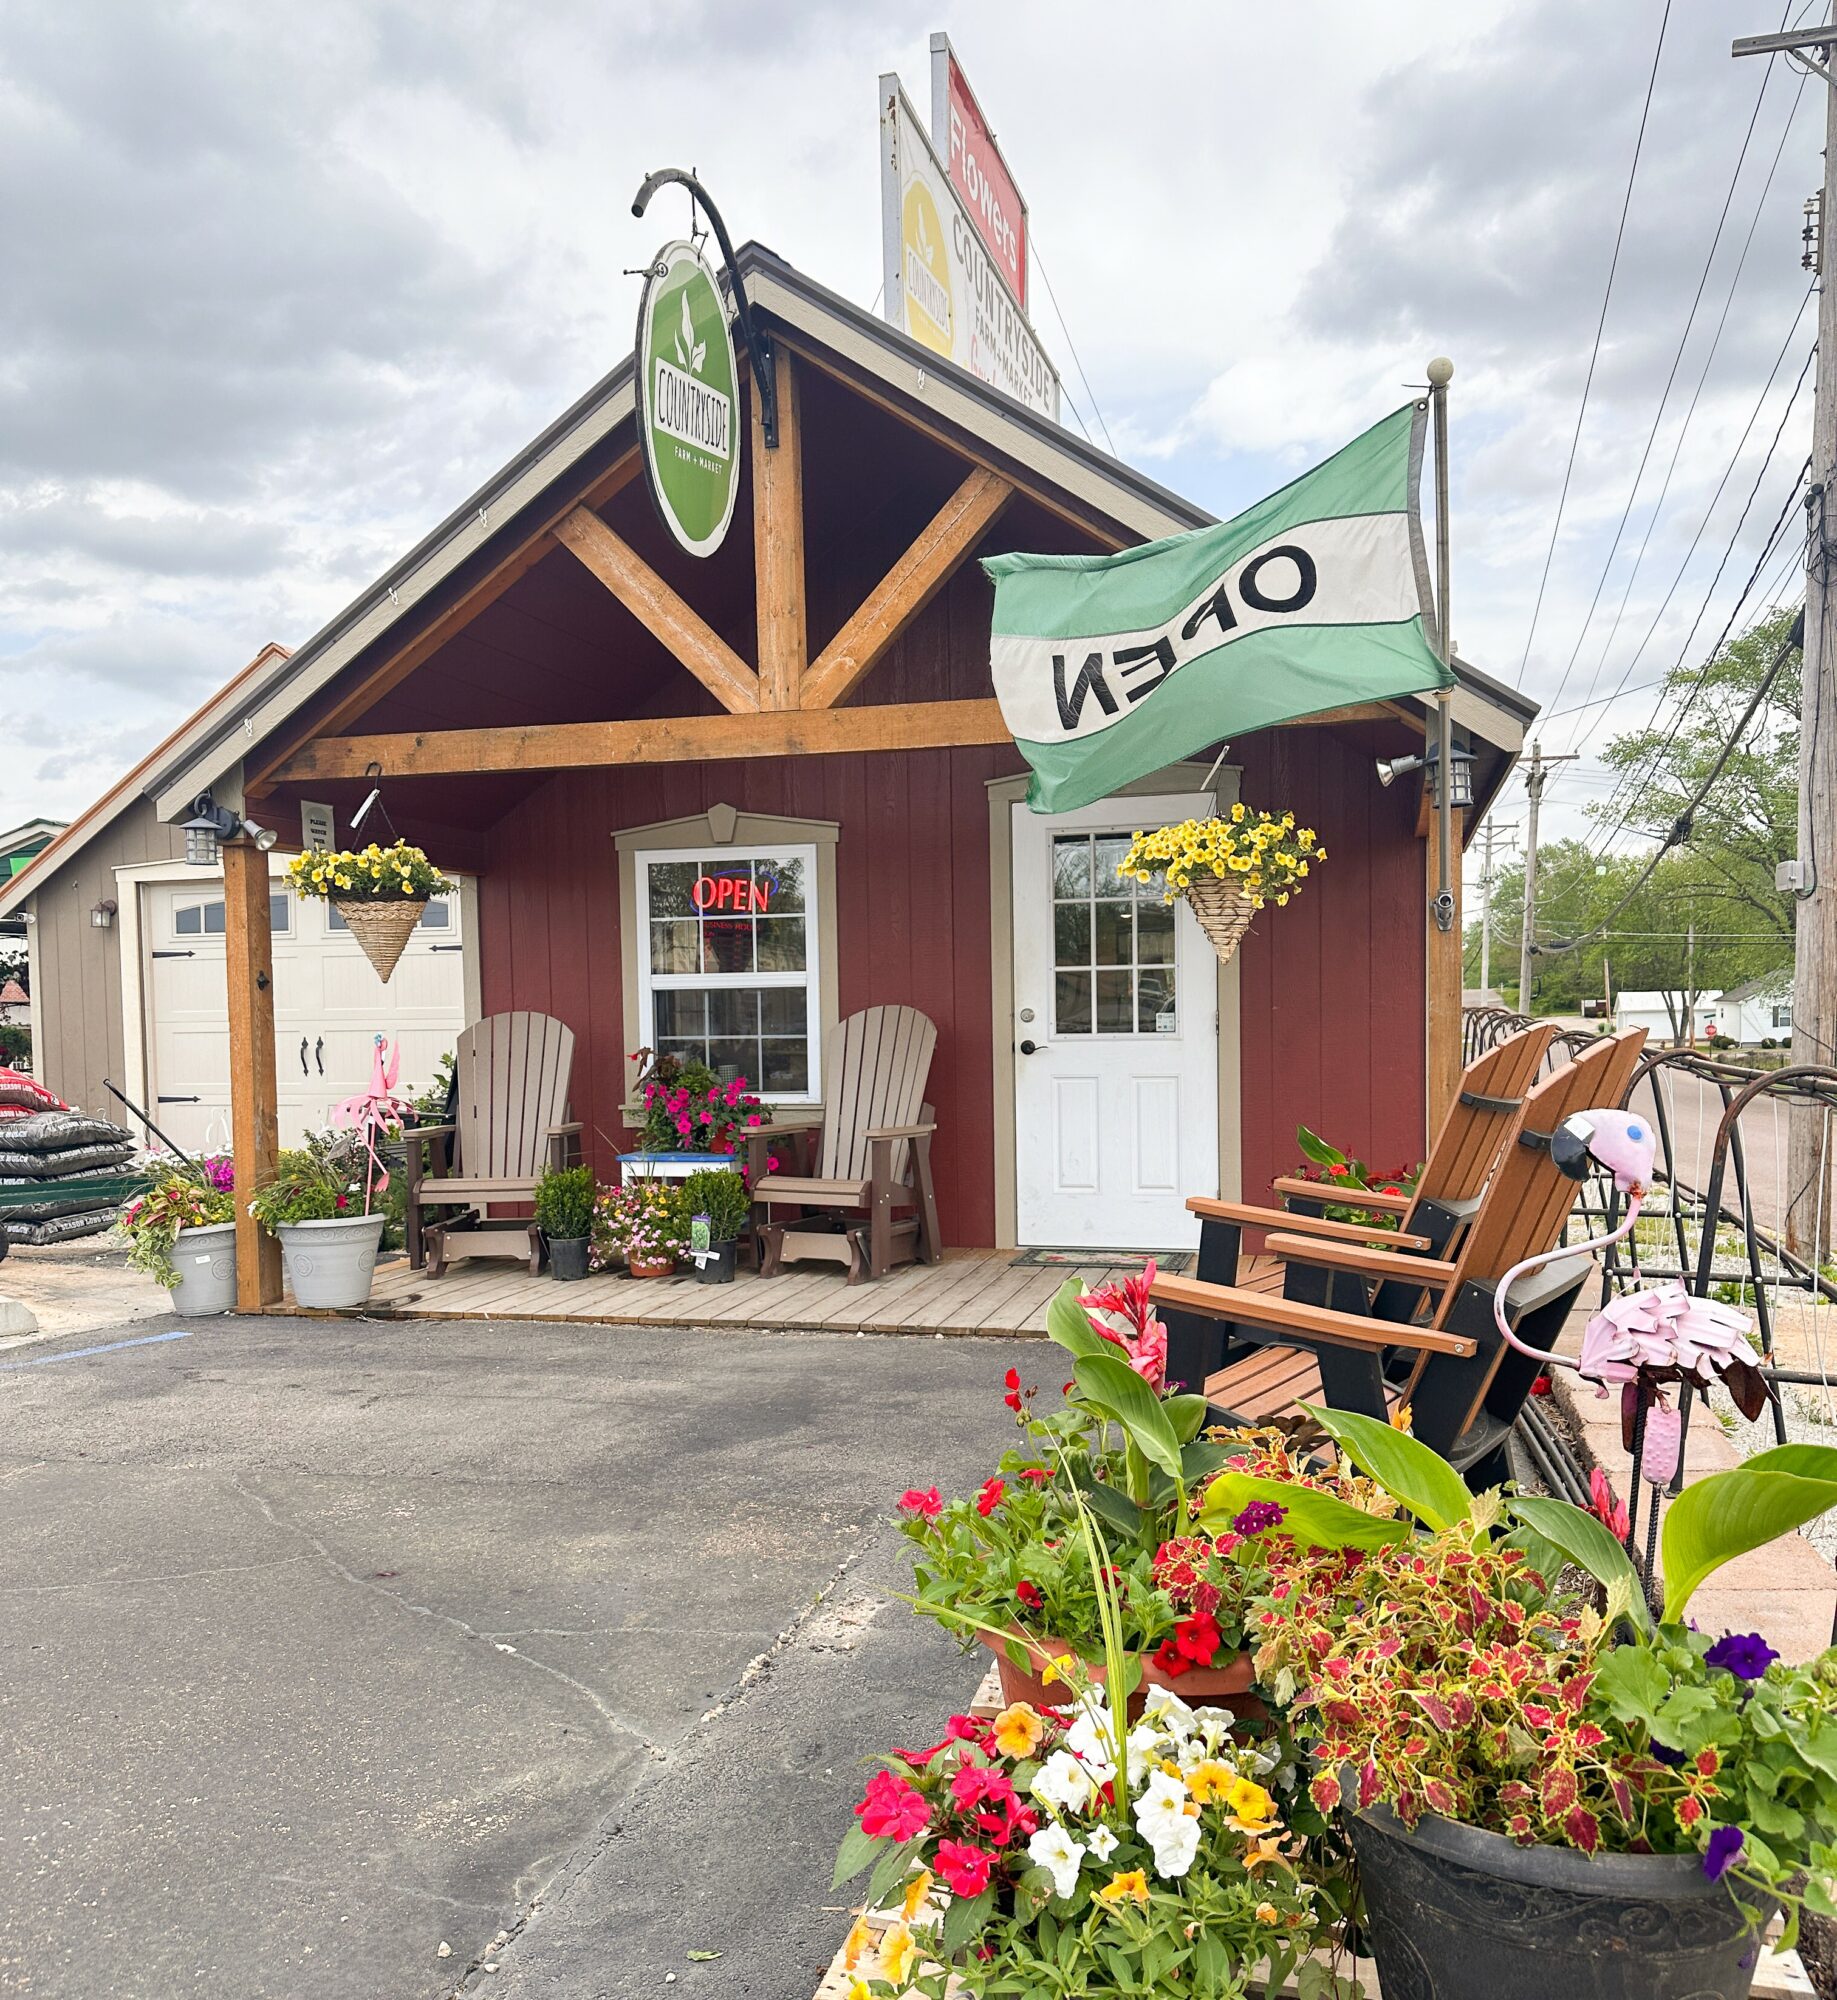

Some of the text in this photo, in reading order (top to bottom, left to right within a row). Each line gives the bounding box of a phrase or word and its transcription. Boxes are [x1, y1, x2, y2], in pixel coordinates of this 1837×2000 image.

[950, 102, 1017, 273] Flowers
[953, 213, 1050, 413] COUNTRYSIDE
[658, 368, 727, 453] COUNTRYSIDE
[674, 445, 691, 463] FARM
[699, 456, 723, 475] MARKET
[693, 876, 769, 912] OPEN
[60, 1220, 85, 1231] SEASON
